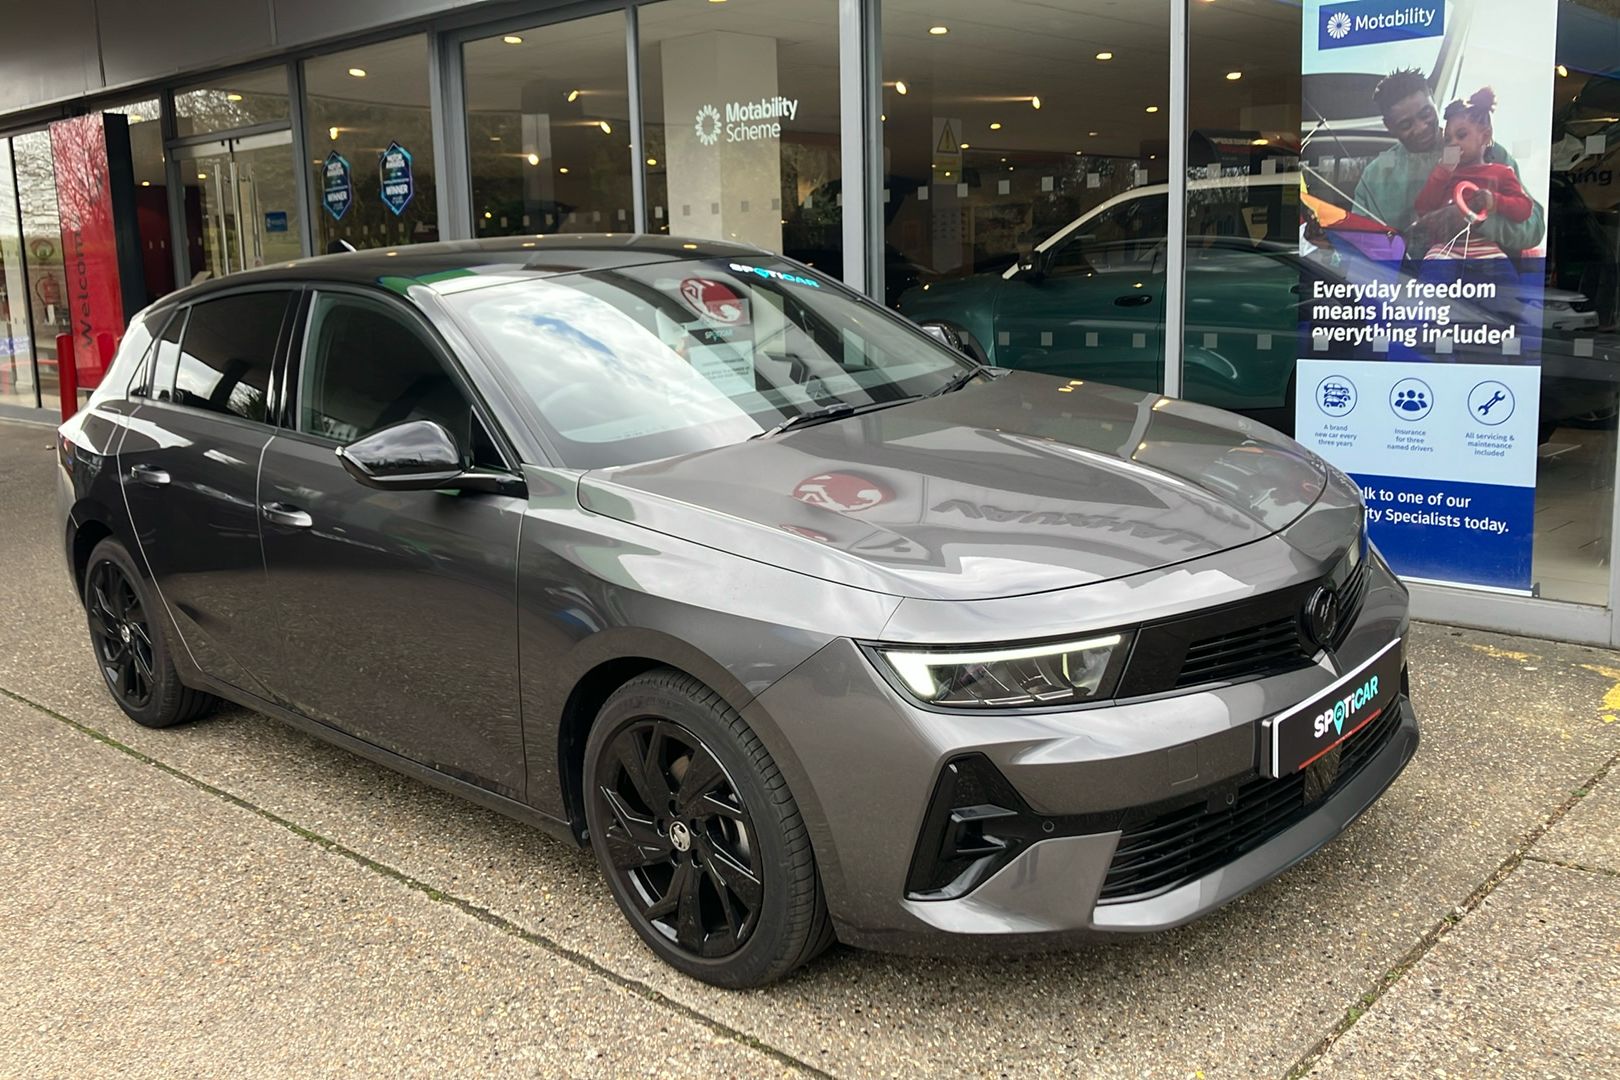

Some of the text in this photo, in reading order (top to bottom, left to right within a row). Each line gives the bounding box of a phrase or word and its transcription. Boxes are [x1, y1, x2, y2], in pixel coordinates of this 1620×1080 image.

[1355, 7, 1436, 32] Motability
[725, 96, 798, 122] Motability
[726, 121, 781, 142] Scheme
[326, 191, 348, 202] WINNER
[385, 184, 409, 196] WINNER
[74, 231, 93, 349] Welcom
[1313, 279, 1496, 303] Everyday freedom
[1312, 301, 1451, 325] means having
[1312, 323, 1418, 347] everything
[1329, 424, 1348, 432] brand
[1394, 428, 1426, 436] Insurance
[1340, 433, 1357, 441] every
[1467, 441, 1513, 449] maintenance
[1476, 433, 1508, 442] servicing
[1410, 444, 1434, 452] drivers
[1474, 449, 1505, 457] included
[1379, 488, 1394, 501] to
[1397, 491, 1424, 504] one
[1428, 492, 1444, 506] of
[1446, 495, 1472, 508] our
[1385, 508, 1461, 528] Specialists
[1464, 516, 1510, 535] today.
